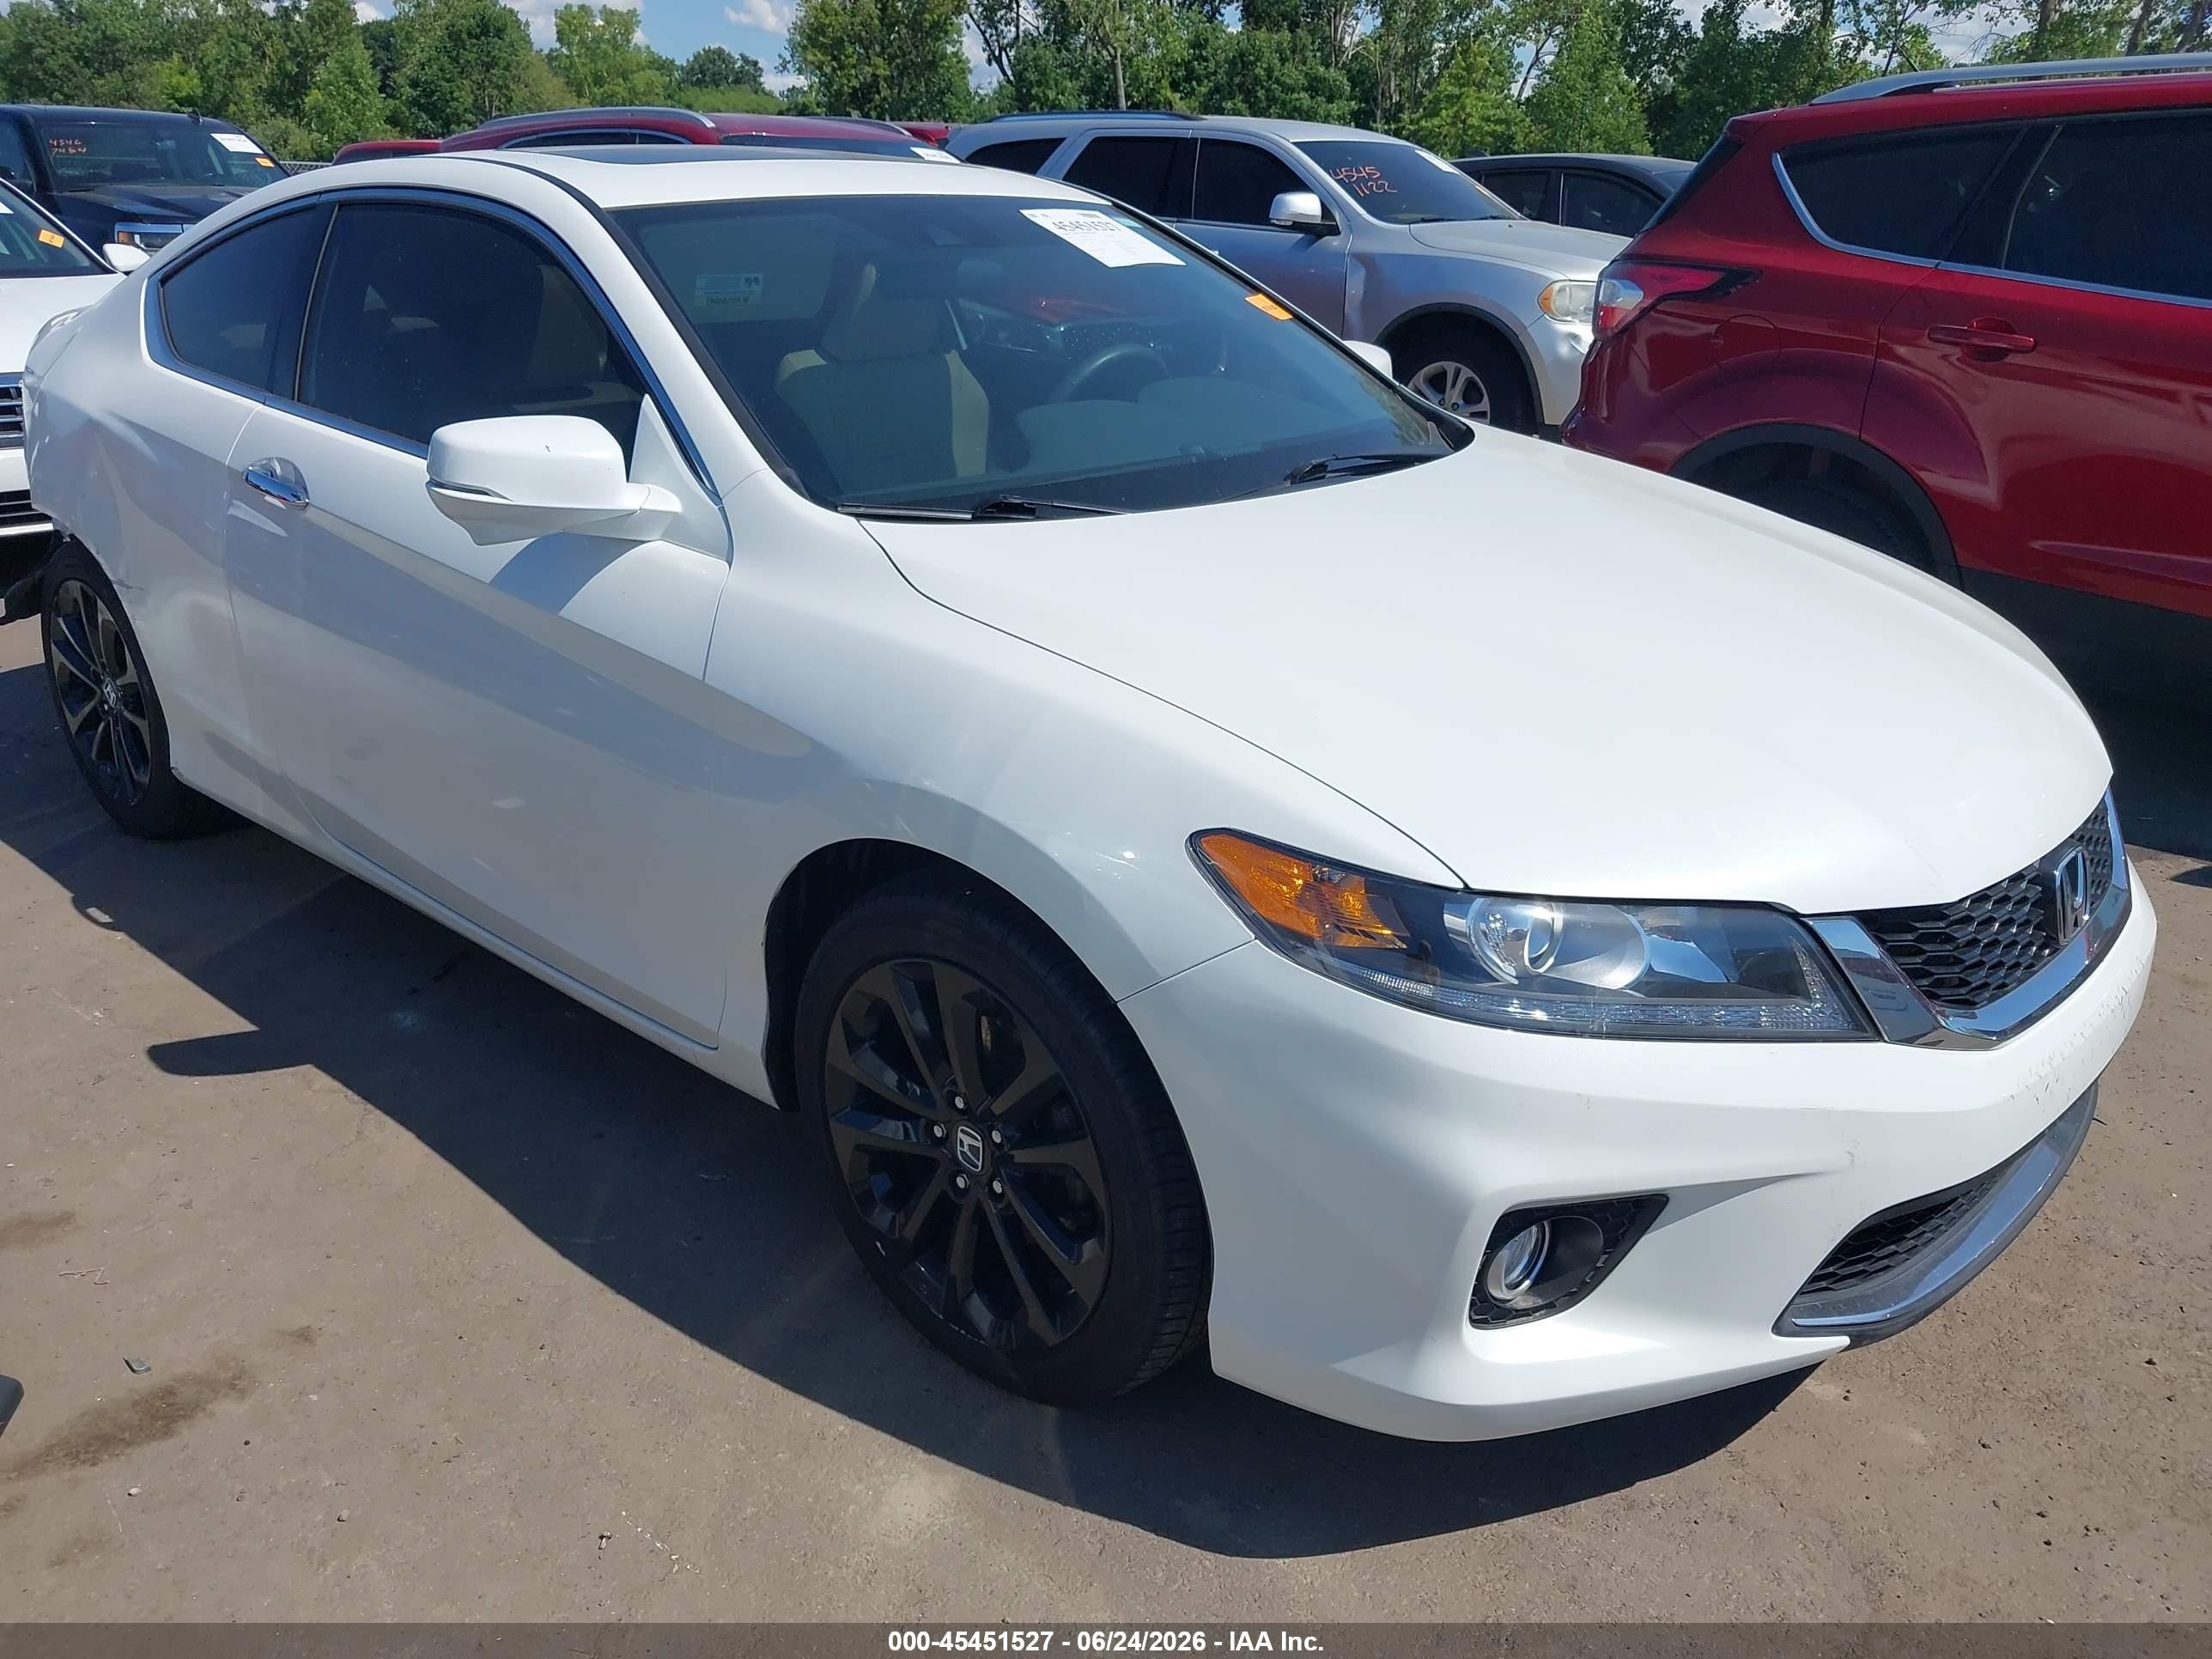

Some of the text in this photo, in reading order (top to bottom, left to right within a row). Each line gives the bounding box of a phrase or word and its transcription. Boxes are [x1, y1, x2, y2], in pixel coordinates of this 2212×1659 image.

[1329, 166, 1381, 183] 4545
[1352, 181, 1398, 198] 1122
[1052, 221, 1121, 232] 45451527
